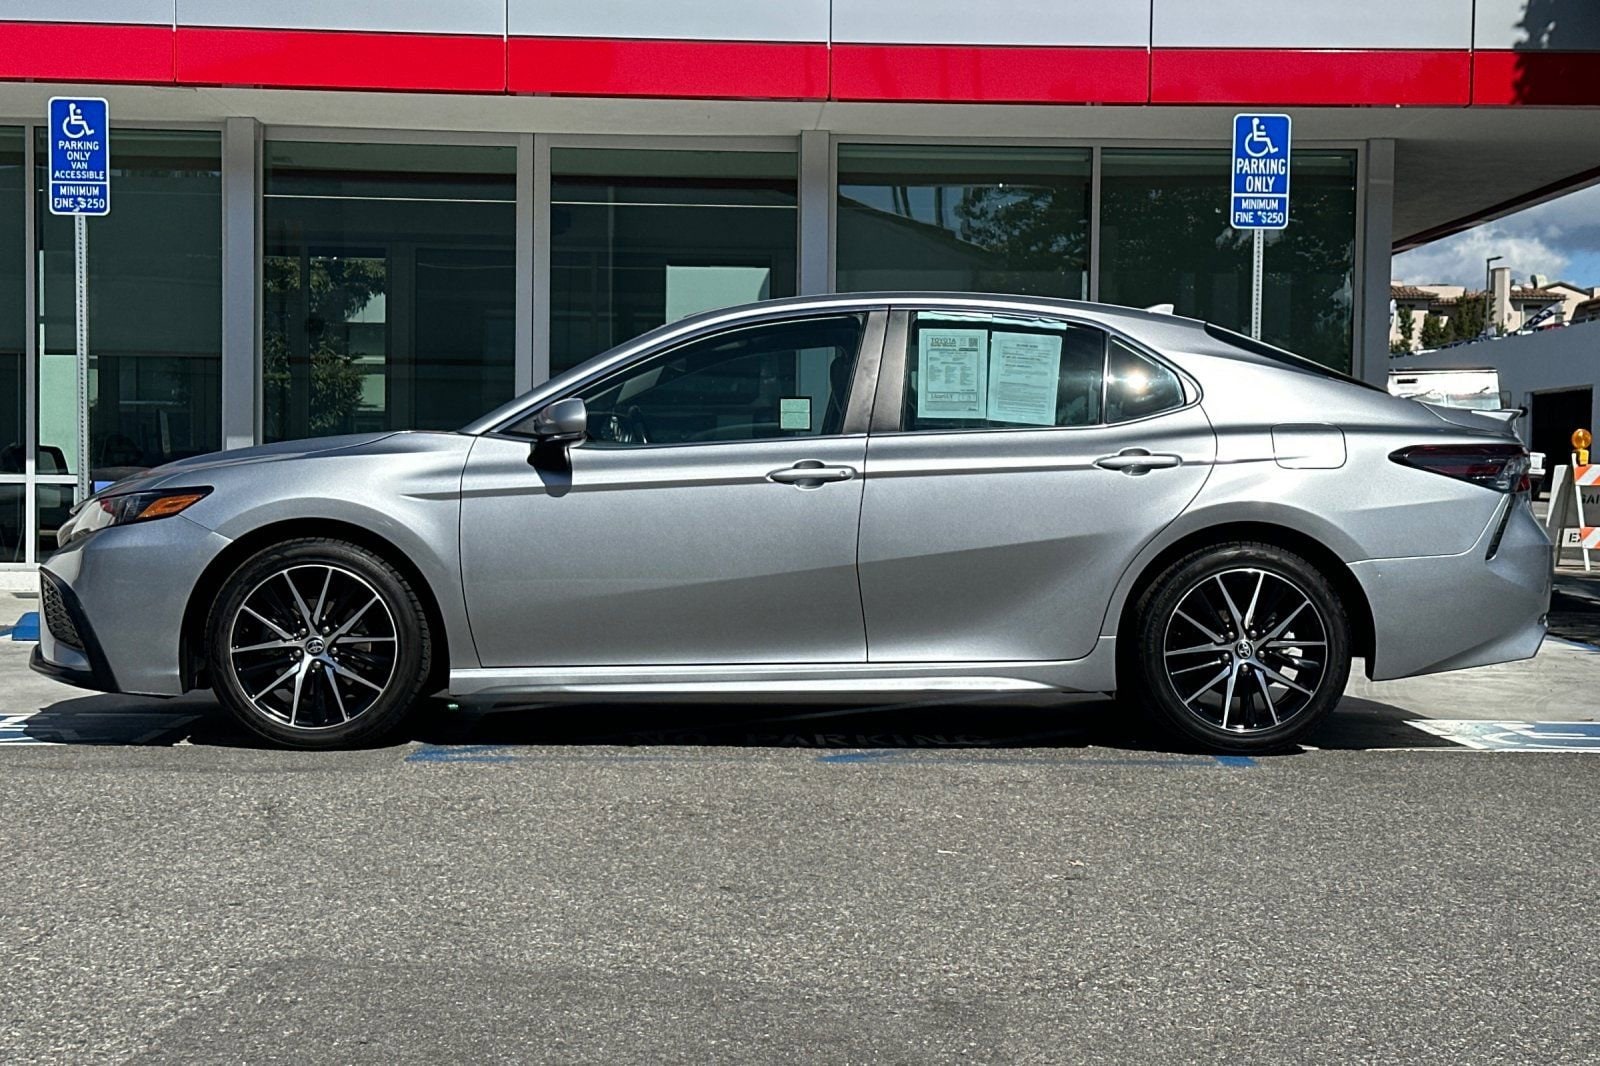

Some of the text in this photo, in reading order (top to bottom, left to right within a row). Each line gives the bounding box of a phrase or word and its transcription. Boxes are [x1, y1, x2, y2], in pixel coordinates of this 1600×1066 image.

[58, 140, 99, 151] PARKING
[66, 151, 91, 161] ONLY
[71, 161, 88, 170] VAN
[1236, 158, 1286, 175] PARKING
[54, 170, 105, 180] ACCESSIBLE
[1245, 175, 1275, 193] ONLY
[59, 185, 100, 196] MINIMUM
[54, 197, 105, 209] FINE $250
[1241, 198, 1279, 210] MINIMUM
[1235, 211, 1284, 224] FINE $250
